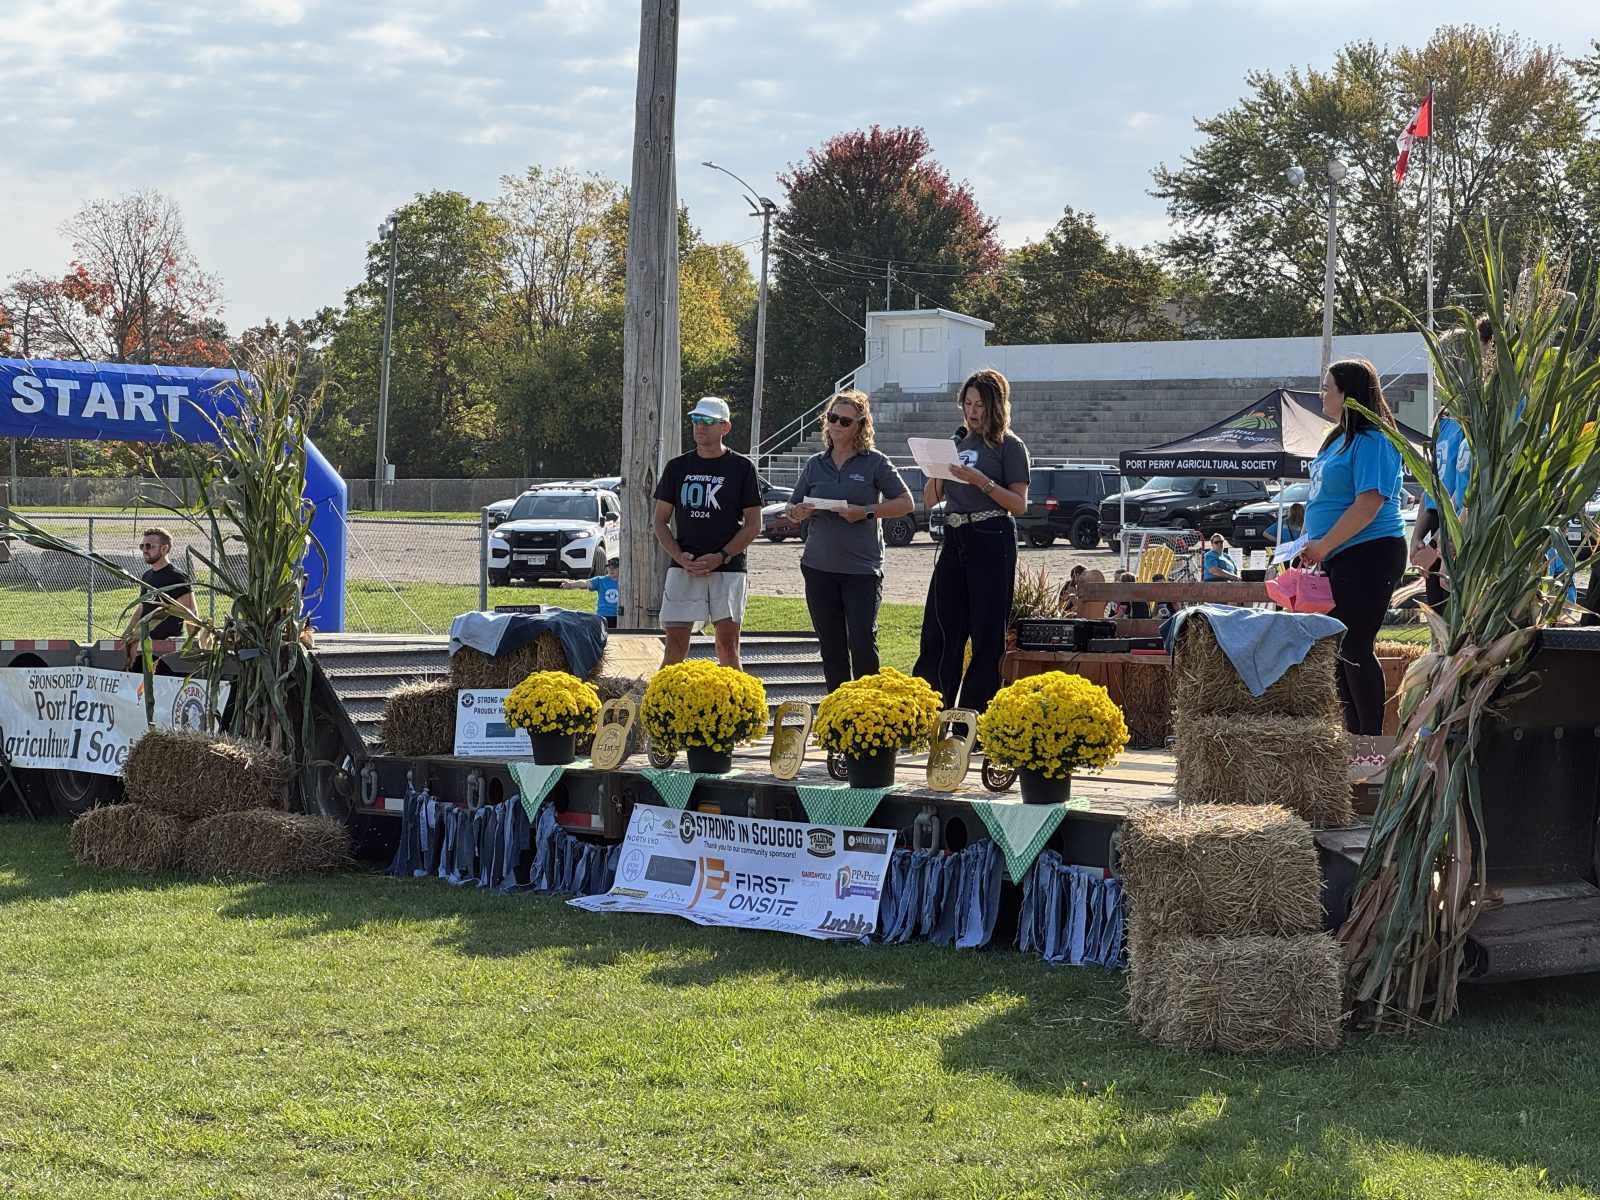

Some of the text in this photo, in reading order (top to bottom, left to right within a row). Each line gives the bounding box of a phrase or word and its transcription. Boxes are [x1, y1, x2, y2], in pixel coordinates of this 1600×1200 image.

[11, 375, 189, 423] START
[1125, 459, 1277, 470] PORT PERRY AGRICULTURAL SOCIETY
[680, 483, 723, 510] 10K
[690, 510, 711, 518] 2024
[100, 677, 120, 694] THE
[477, 696, 499, 704] STRONG
[34, 689, 115, 732] Port Perry
[473, 707, 498, 715] PROUDLY
[788, 703, 804, 713] 2025
[946, 711, 967, 721] 2025
[696, 815, 736, 841] STRONG
[738, 823, 750, 844] IN
[626, 834, 647, 844] NORTH
[647, 837, 659, 845] END
[810, 834, 833, 847] TRADING
[703, 840, 718, 850] Thank
[740, 847, 768, 858] community
[769, 849, 797, 859] sponsors!
[735, 872, 791, 896] FIRST
[728, 893, 799, 917] ONSITE
